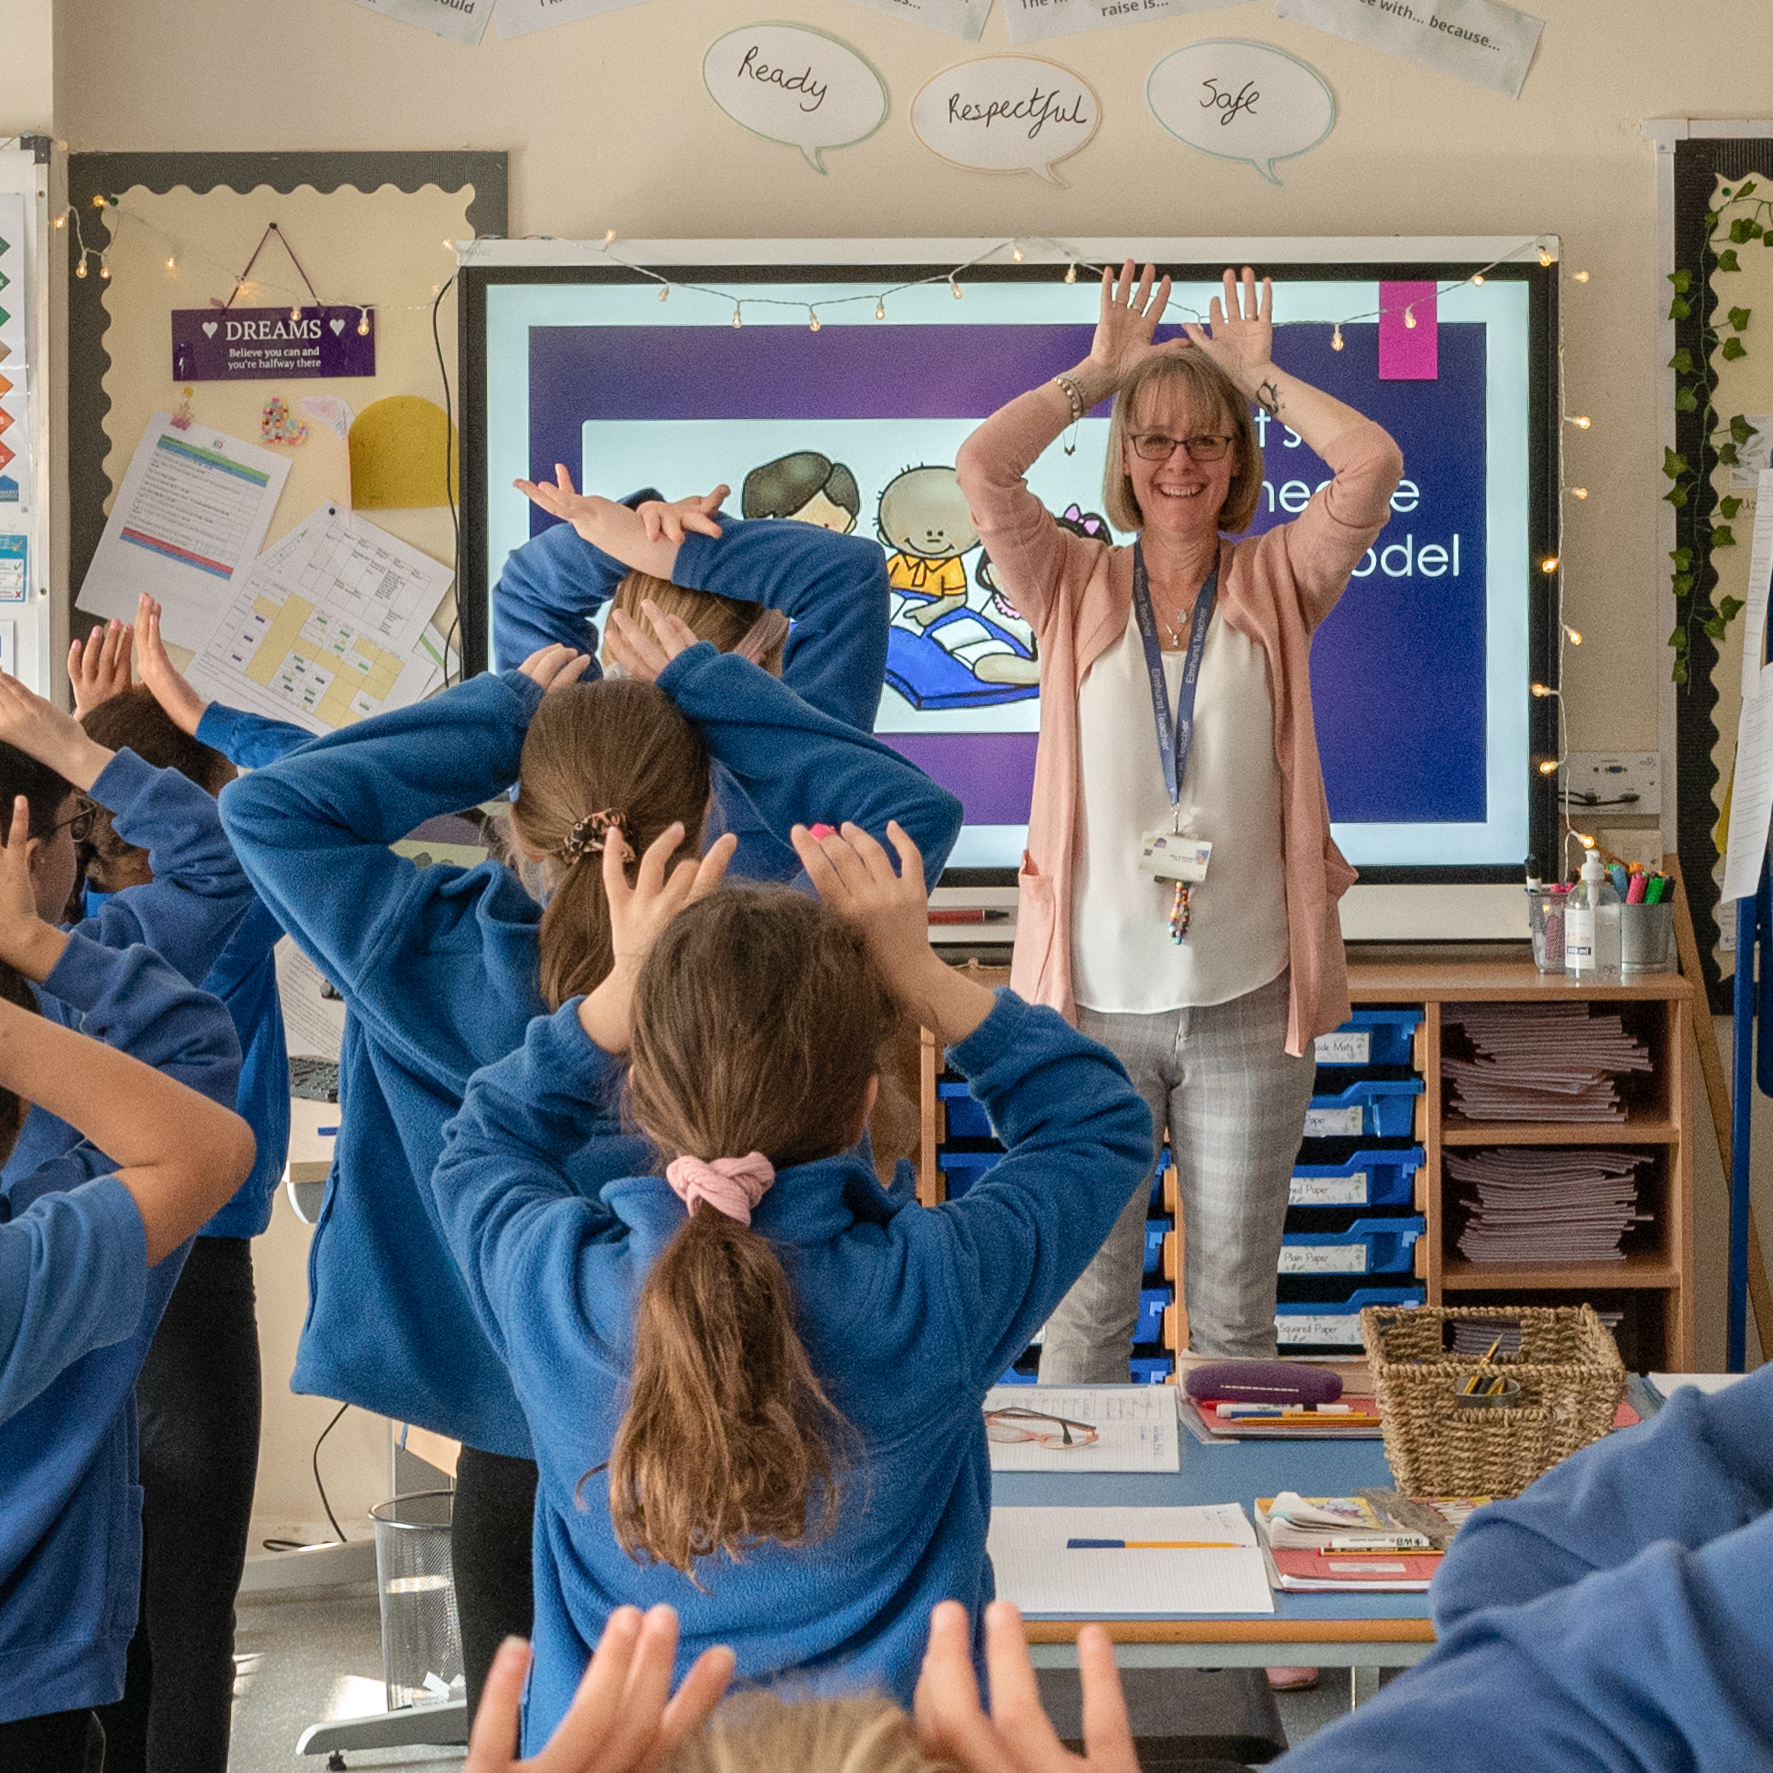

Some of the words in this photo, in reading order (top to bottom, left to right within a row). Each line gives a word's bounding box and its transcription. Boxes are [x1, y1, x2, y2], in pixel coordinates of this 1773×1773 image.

[1101, 3, 1139, 17] raise
[1428, 15, 1501, 51] because...
[738, 46, 827, 112] Ready
[949, 87, 1087, 139] Respectful
[1200, 78, 1260, 126] Safe
[225, 320, 322, 341] DREAMS
[228, 359, 257, 370] you're
[258, 357, 295, 370] halfway
[296, 358, 321, 367] there
[229, 348, 263, 358] Believe
[264, 350, 282, 359] you
[283, 349, 301, 357] can
[302, 347, 320, 356] and
[1350, 534, 1459, 577] odel
[1193, 608, 1208, 643] Teacher
[1186, 644, 1201, 684] Elmhurst
[1151, 668, 1165, 709] Elmhurst
[1158, 713, 1170, 751] Teacher
[1306, 1186, 1328, 1197] Paper
[1284, 1252, 1303, 1262] Plain
[1306, 1252, 1329, 1265] Paper
[1279, 1324, 1312, 1334] Squared
[1314, 1324, 1337, 1335] Paper
